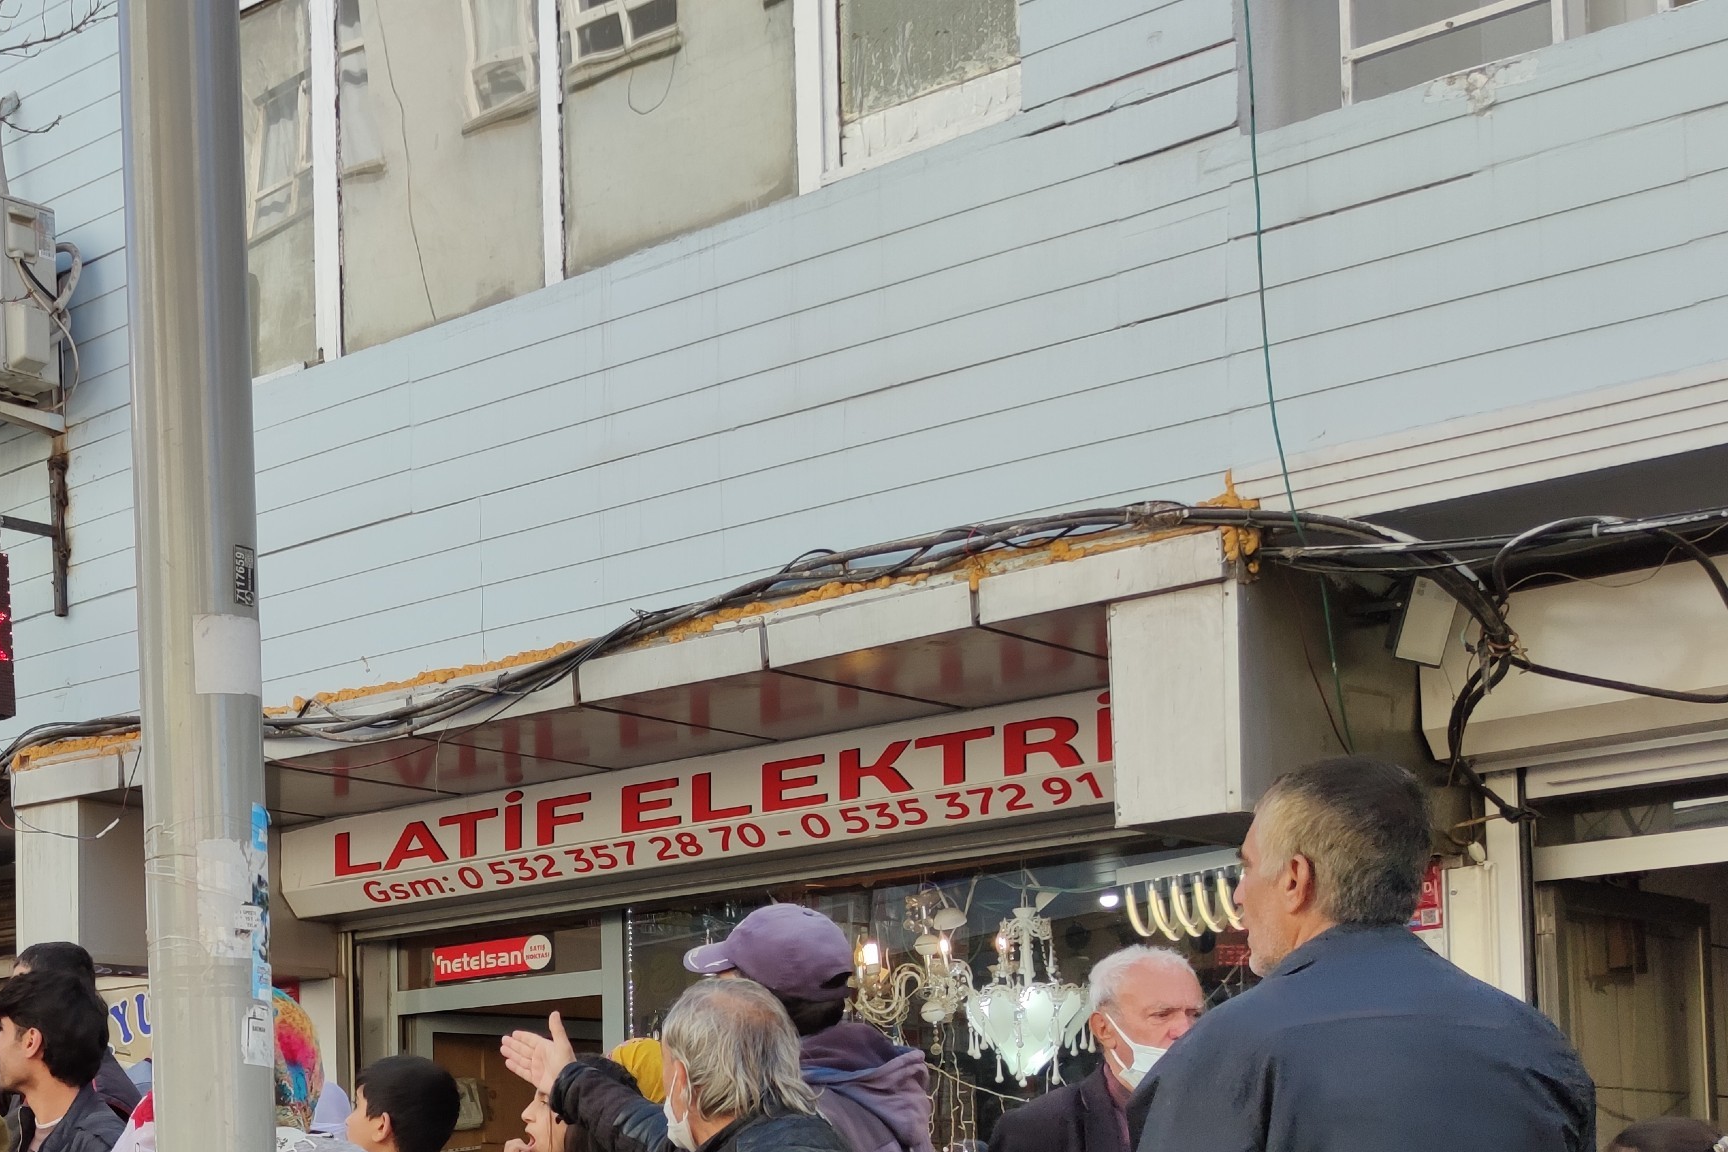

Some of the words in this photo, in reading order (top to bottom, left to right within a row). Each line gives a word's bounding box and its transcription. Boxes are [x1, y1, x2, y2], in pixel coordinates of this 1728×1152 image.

[334, 790, 592, 877] LATİF
[486, 854, 563, 886] 532
[564, 840, 637, 873] 357
[648, 832, 704, 862] 28
[708, 822, 767, 853] 70
[839, 798, 929, 834] 535
[935, 783, 1034, 820] 372
[1041, 771, 1104, 805] 91
